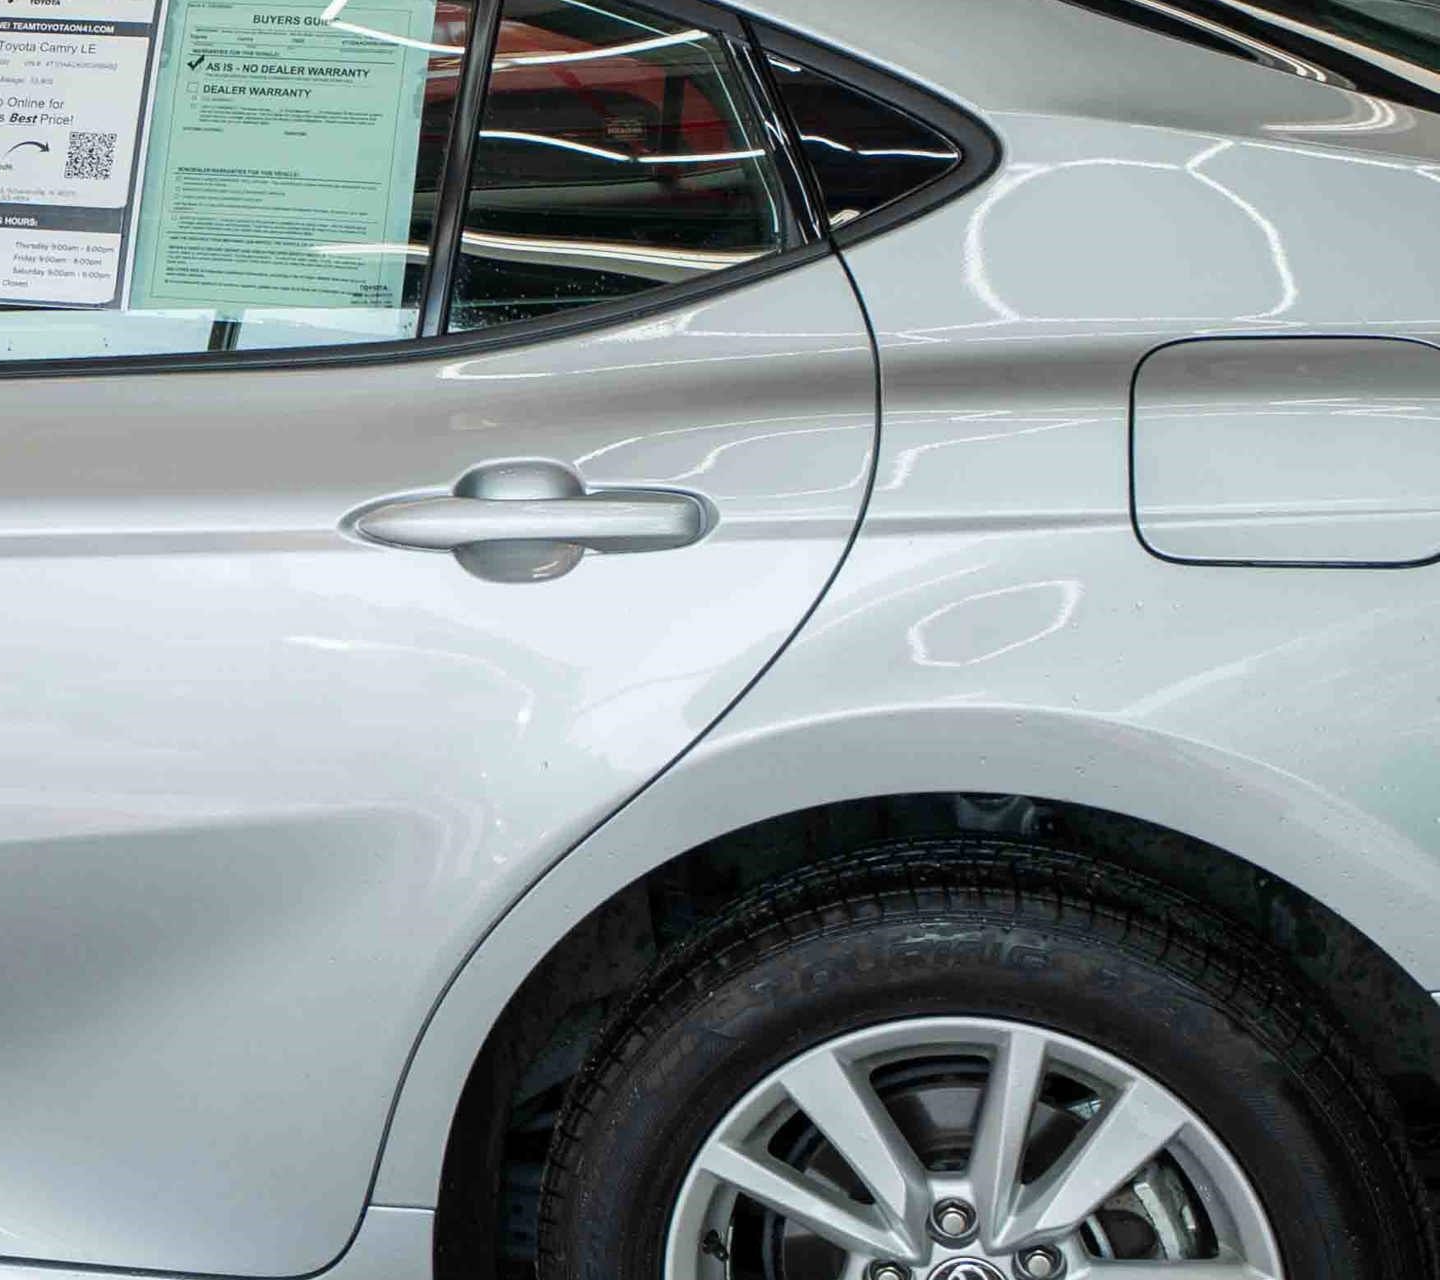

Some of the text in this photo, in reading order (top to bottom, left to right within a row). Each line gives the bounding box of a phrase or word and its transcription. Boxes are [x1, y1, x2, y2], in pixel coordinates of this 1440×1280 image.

[253, 14, 301, 26] BUYERS
[39, 41, 79, 55] Camry
[80, 43, 97, 55] LE
[206, 62, 220, 72] AS
[223, 62, 234, 72] IS
[242, 63, 259, 74] NO
[261, 64, 306, 75] DEALER
[307, 66, 370, 78] WARRANTY
[203, 83, 312, 98] DEALER WARRANTY
[7, 96, 46, 109] Online
[48, 98, 66, 109] for
[9, 113, 38, 124] Best
[40, 114, 75, 126] Price!
[4, 215, 39, 227] HOURS:
[15, 241, 49, 252] Thursday
[13, 253, 36, 264] Friday
[12, 266, 45, 278] Saturday
[2, 278, 29, 288] Closed
